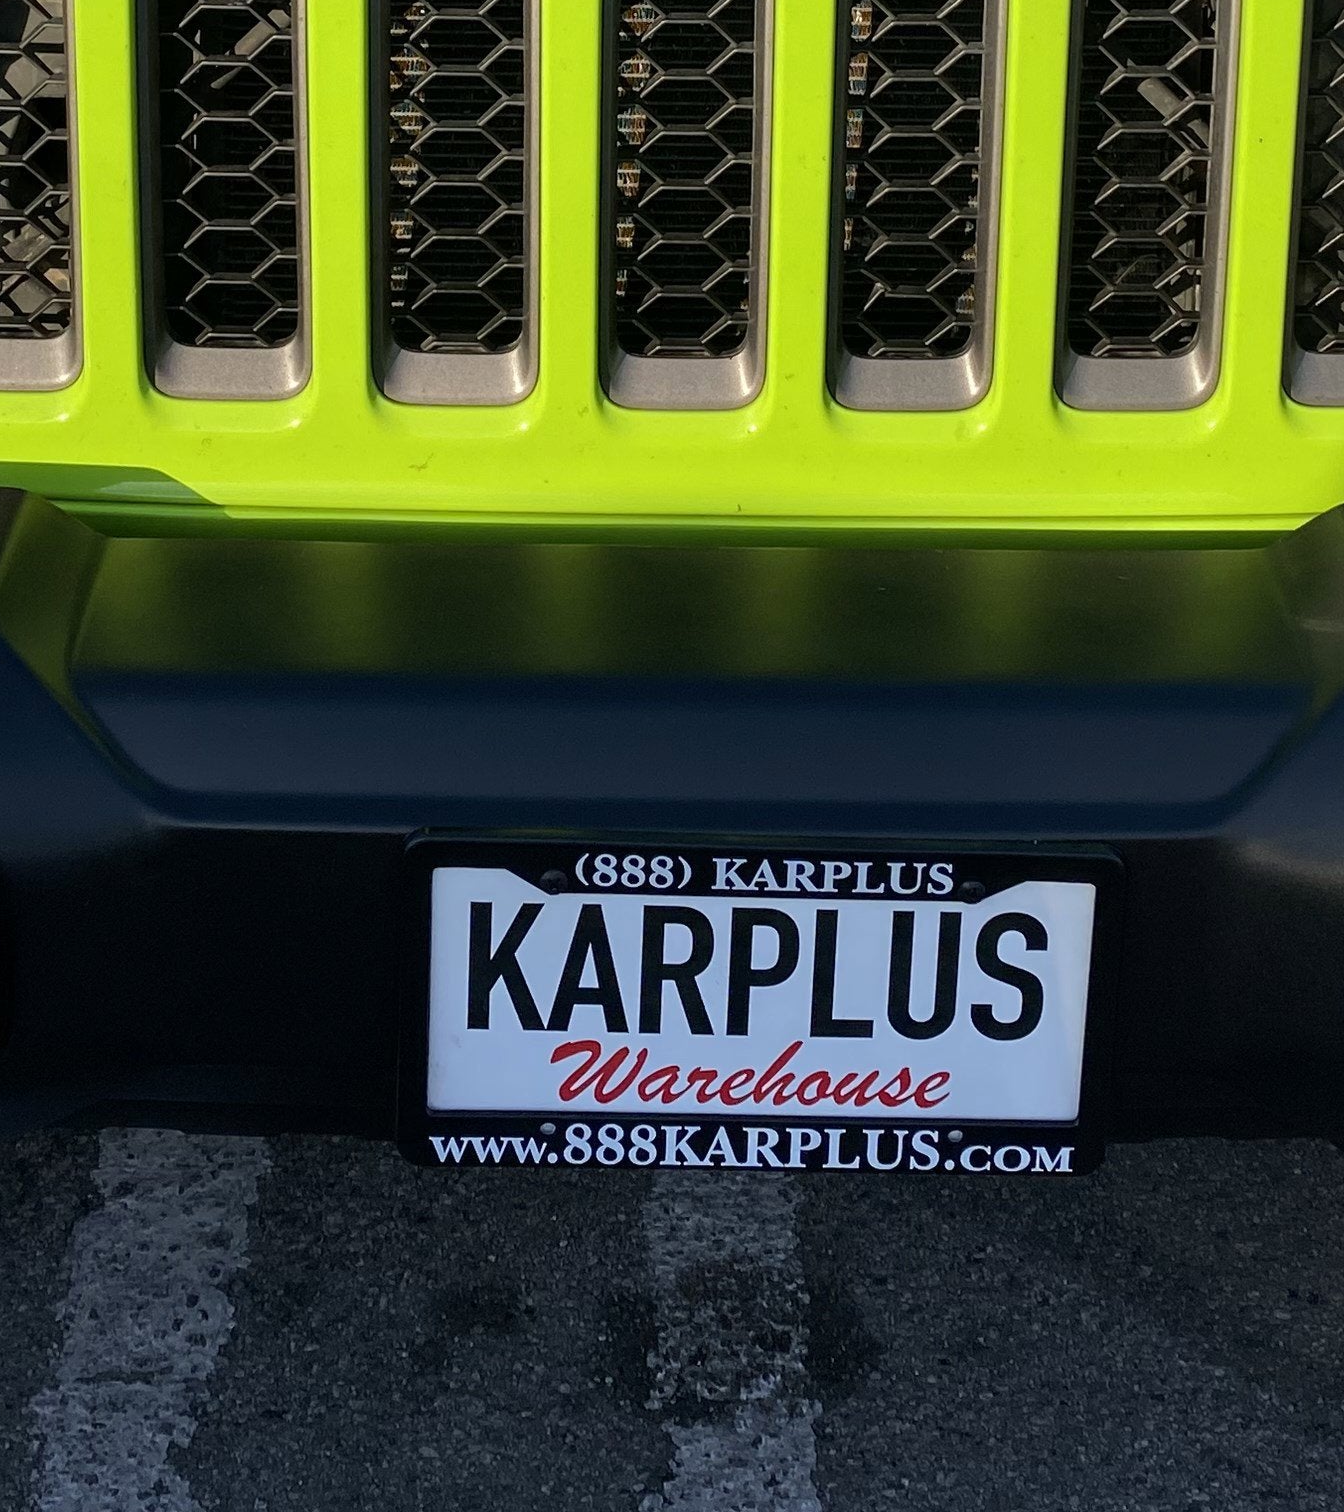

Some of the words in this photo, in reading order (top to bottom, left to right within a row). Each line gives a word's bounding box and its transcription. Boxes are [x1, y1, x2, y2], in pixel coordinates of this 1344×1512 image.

[575, 853, 693, 890] (888)
[711, 857, 955, 895] KARPLUS
[466, 901, 1049, 1041] KARPLUS
[550, 1040, 951, 1109] Warehouse
